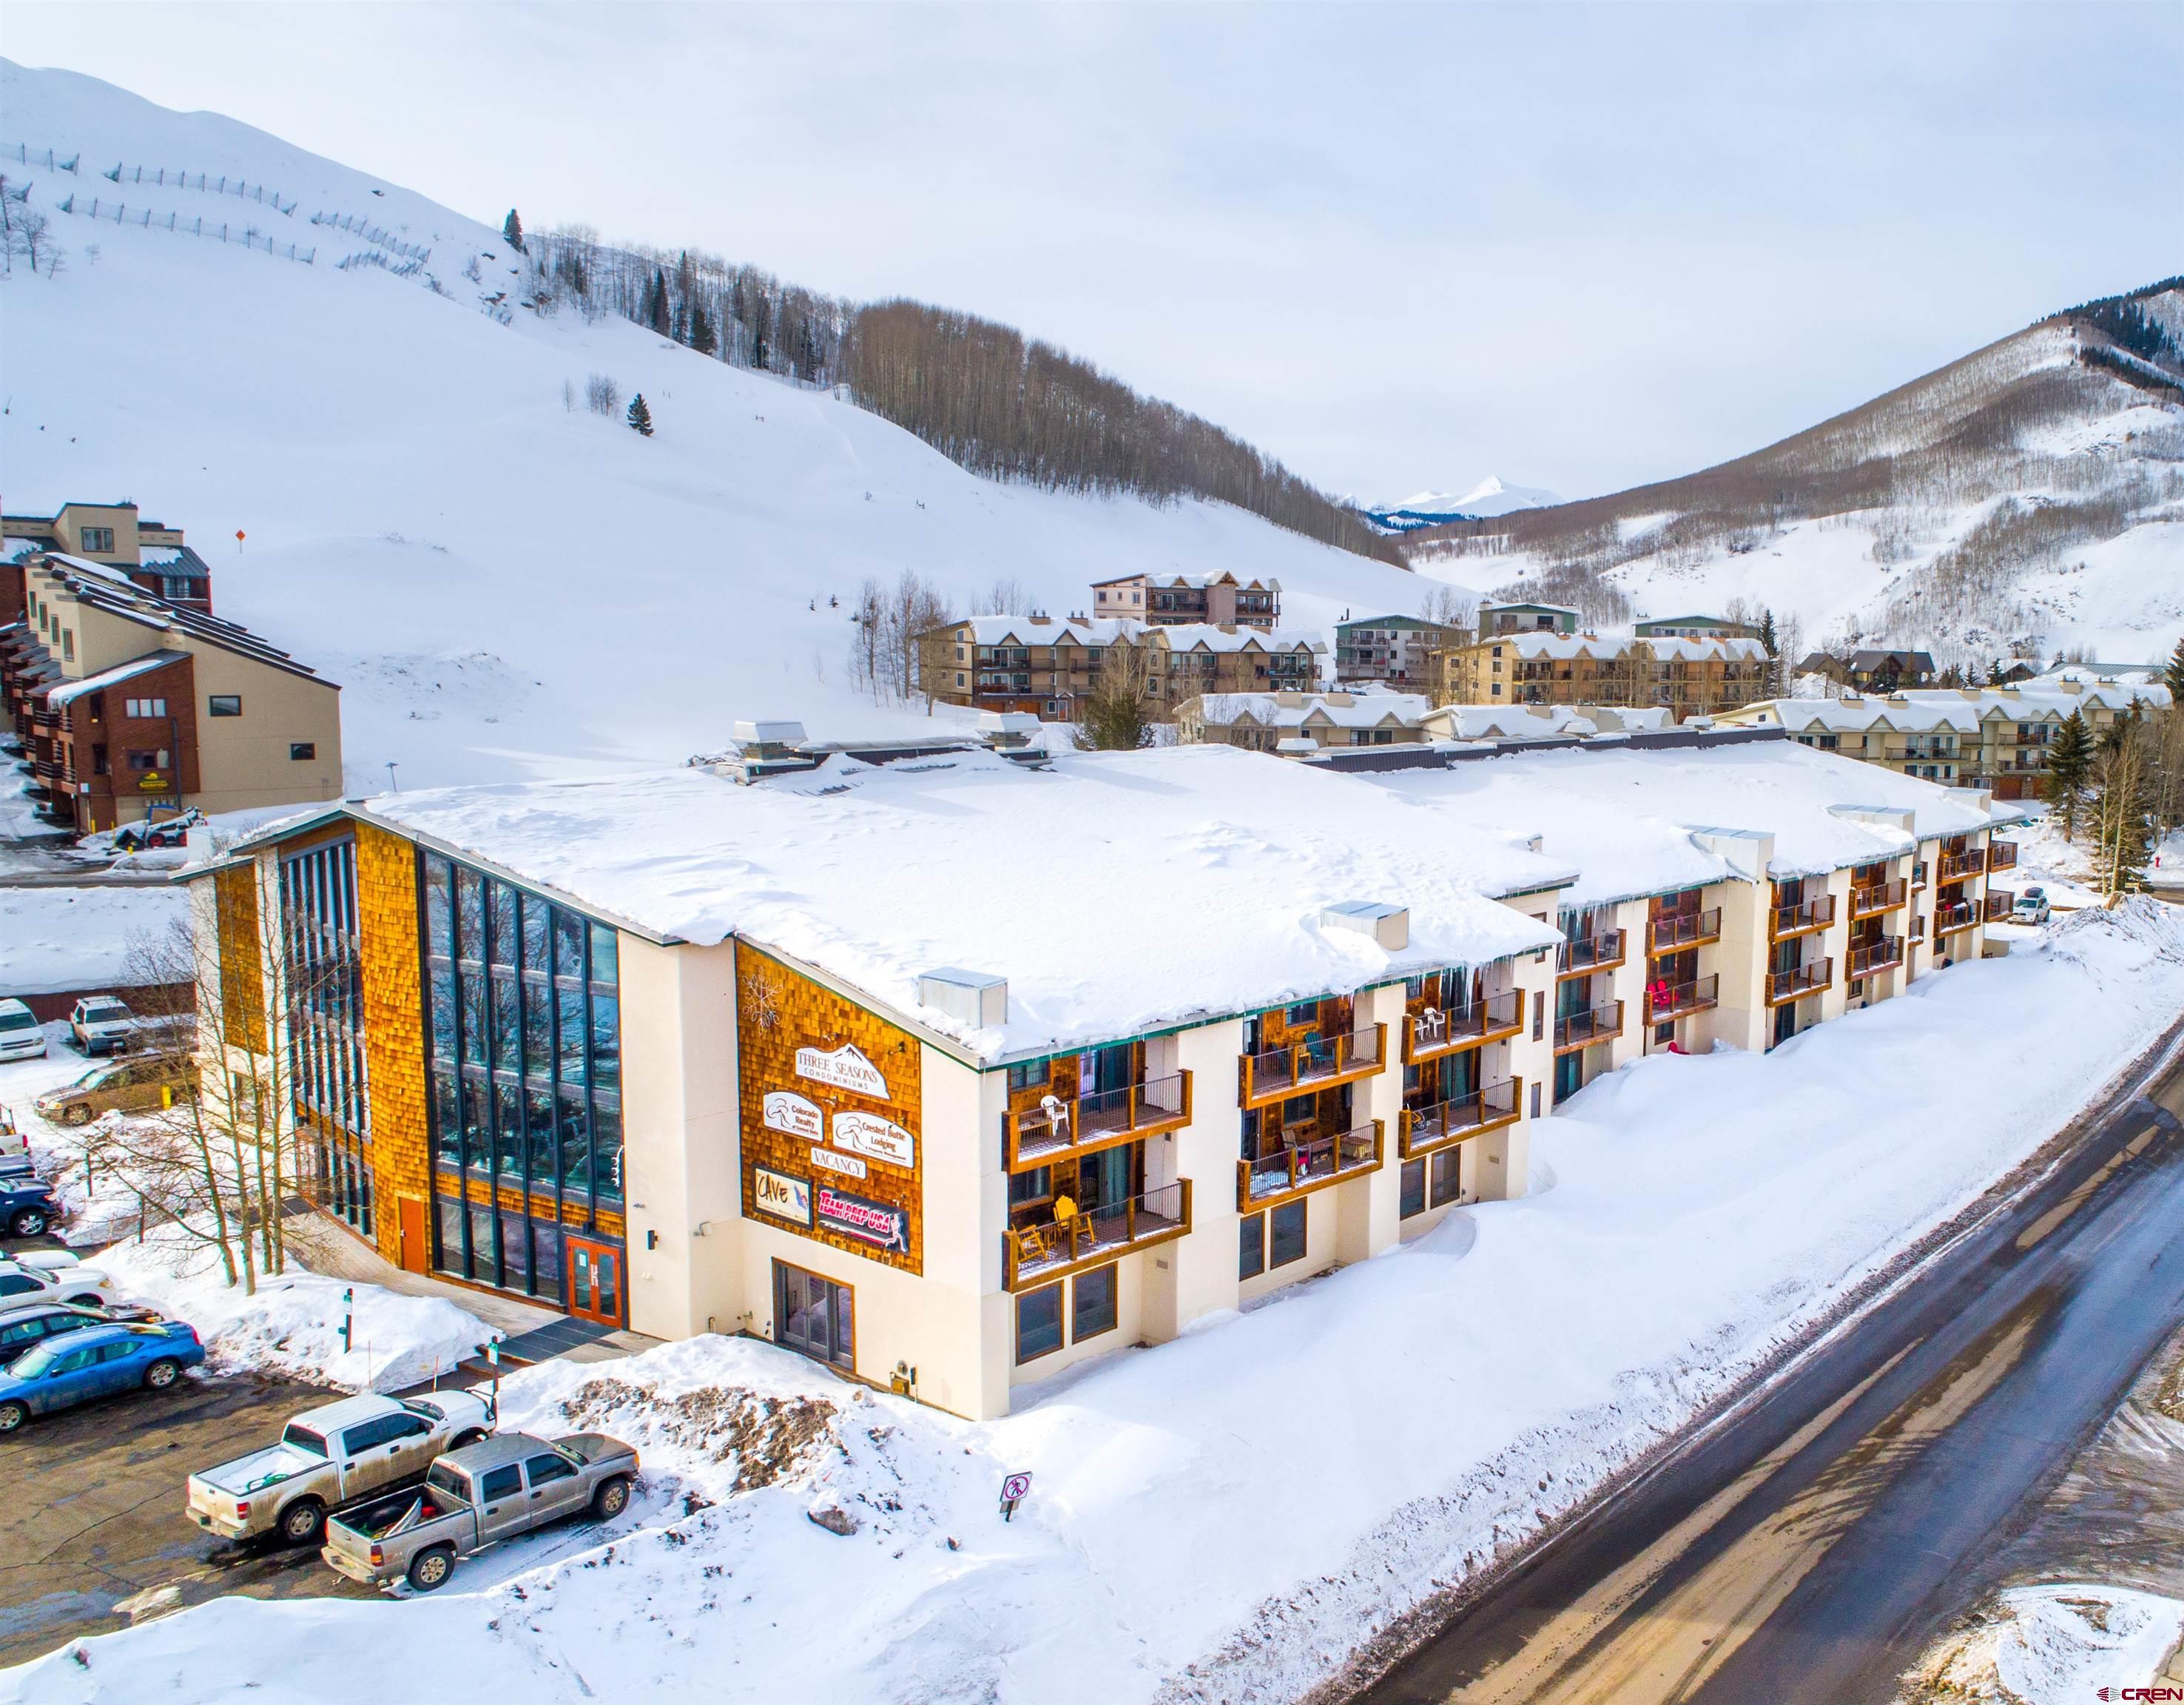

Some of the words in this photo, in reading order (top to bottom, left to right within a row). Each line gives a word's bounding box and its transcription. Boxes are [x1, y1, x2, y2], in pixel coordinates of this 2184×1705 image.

[798, 1052, 830, 1072] THREE
[835, 1061, 878, 1084] SEASONS
[804, 1067, 869, 1090] CONDOMINIUMS
[792, 1105, 818, 1118] Colorado
[795, 1116, 815, 1129] Realty
[862, 1122, 886, 1136] Crested
[888, 1129, 906, 1141] Butte
[871, 1136, 897, 1153] Lodging
[814, 1150, 863, 1175] VACANCY
[758, 1174, 788, 1203] CAVE
[868, 1210, 890, 1234] USA
